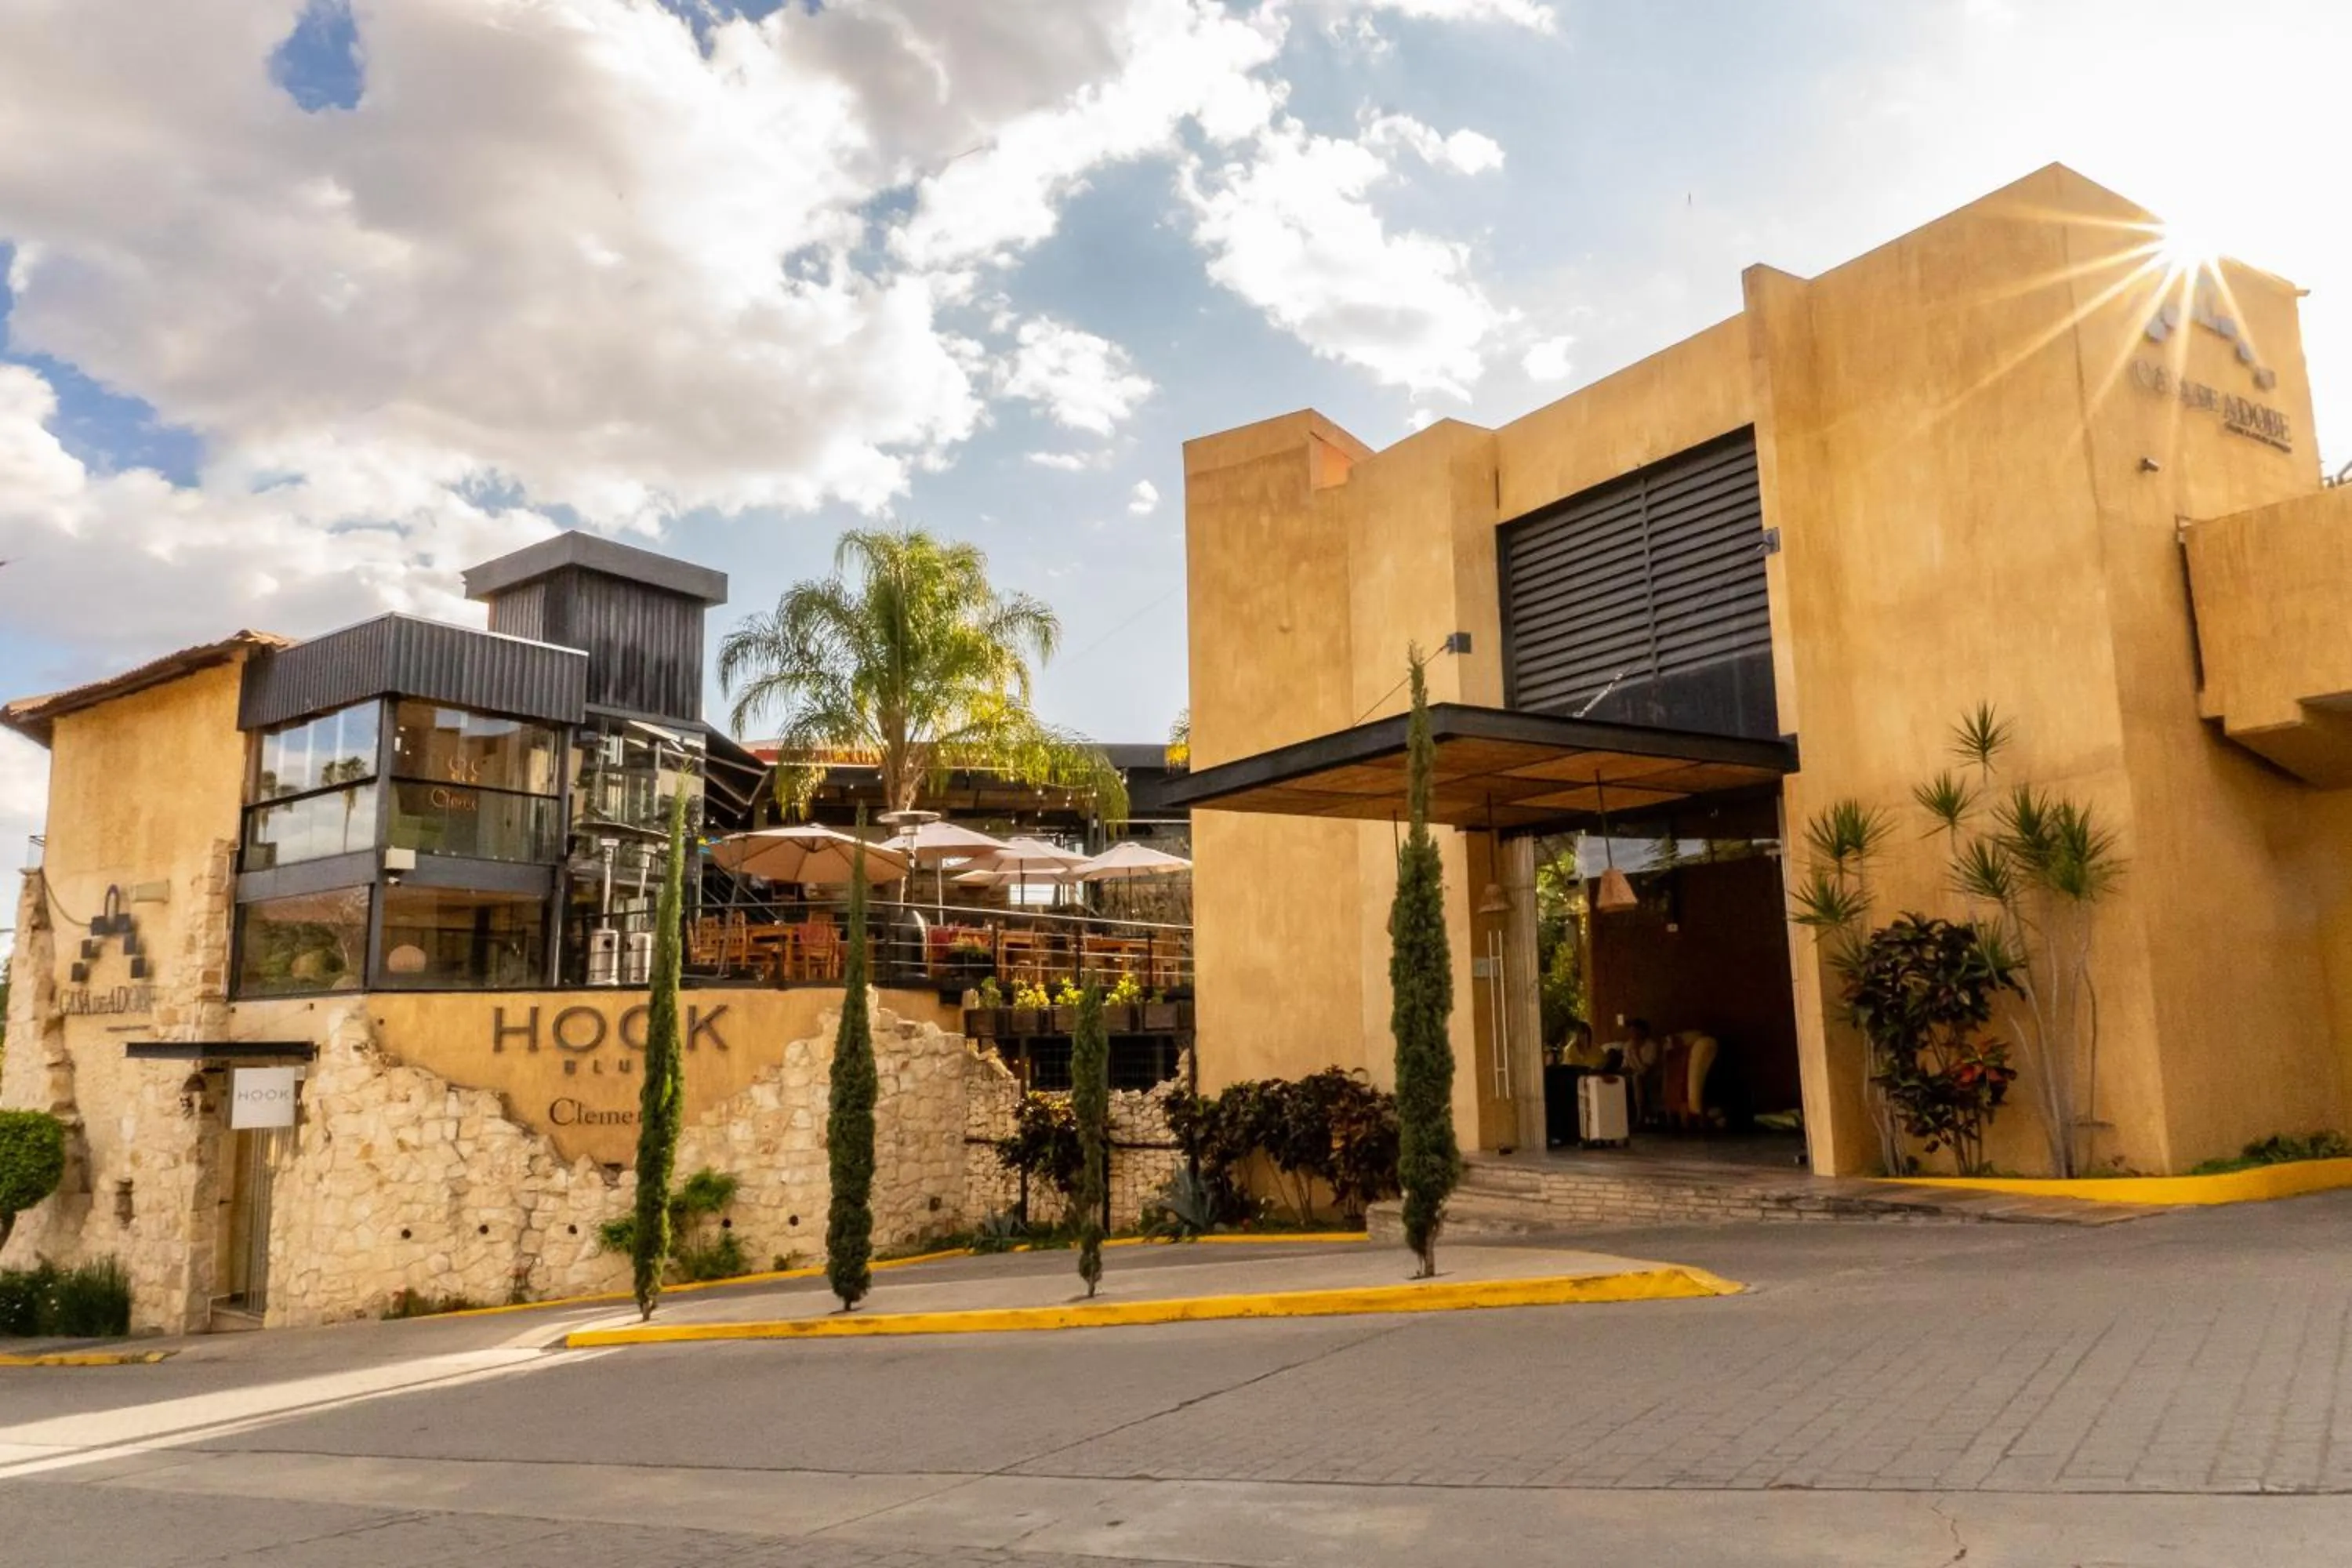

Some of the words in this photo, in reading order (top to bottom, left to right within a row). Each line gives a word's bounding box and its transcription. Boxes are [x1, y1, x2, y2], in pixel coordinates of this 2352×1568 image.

[2223, 392, 2292, 442] ADOBE
[493, 1004, 729, 1053] HOOK
[564, 1059, 631, 1075] BLU
[238, 1088, 289, 1102] HOOK
